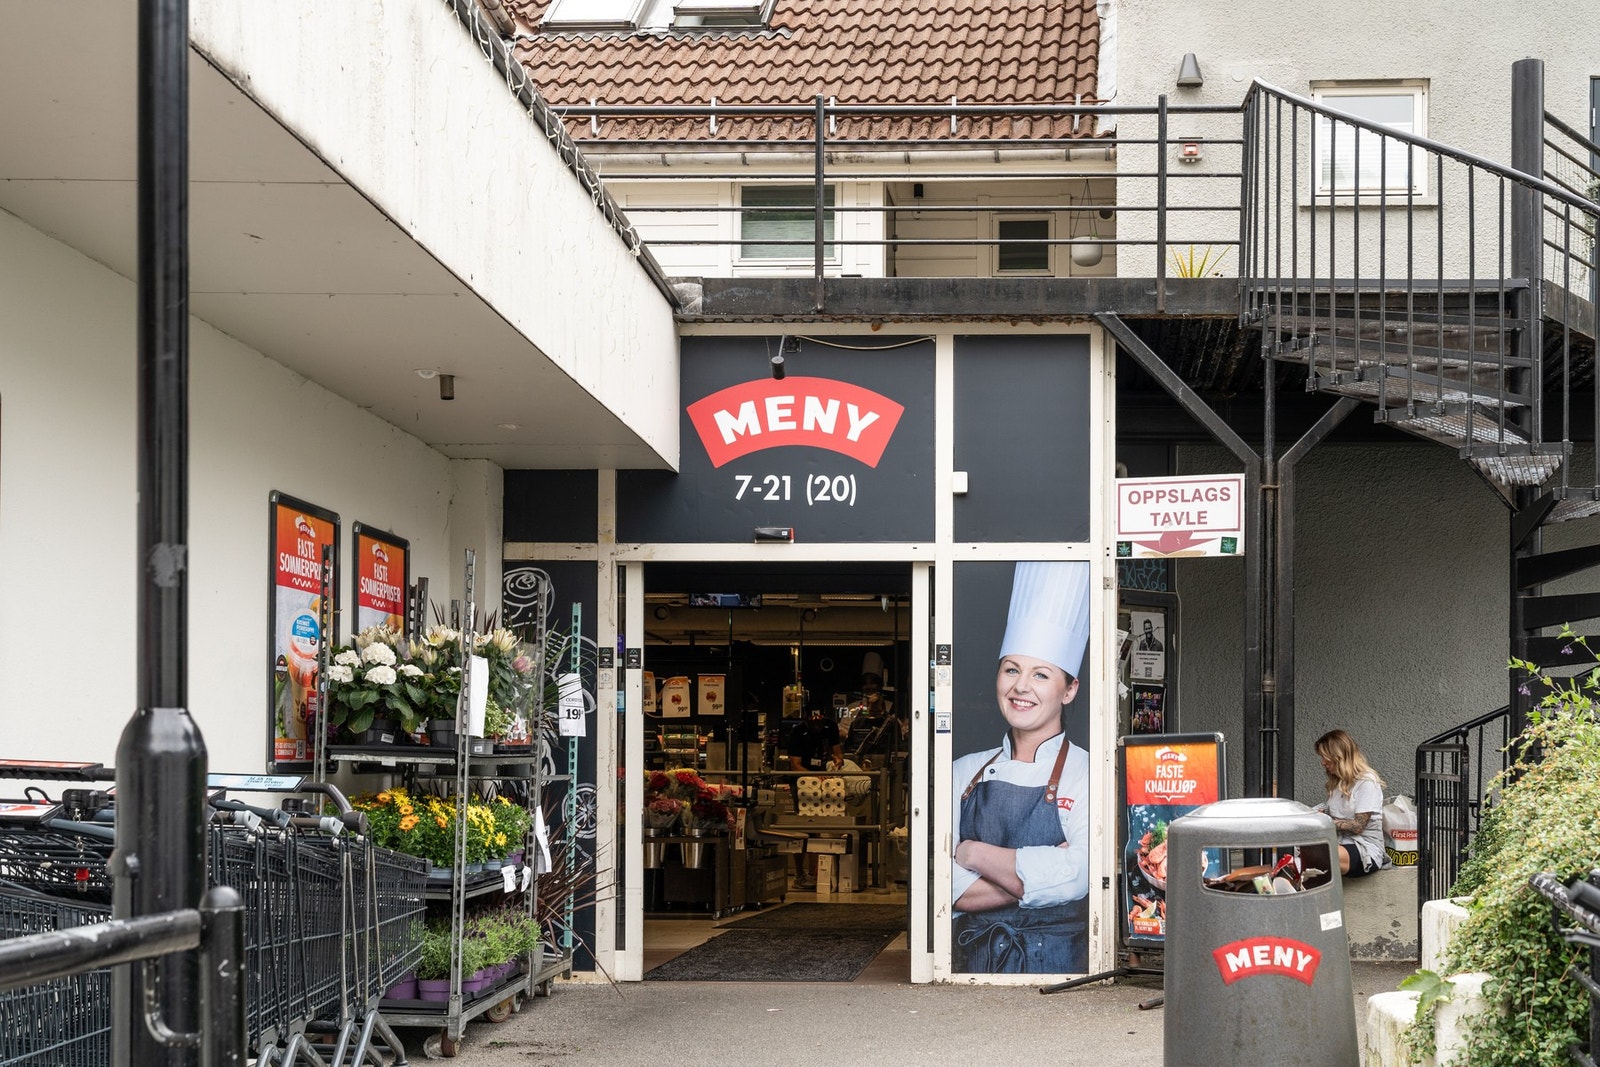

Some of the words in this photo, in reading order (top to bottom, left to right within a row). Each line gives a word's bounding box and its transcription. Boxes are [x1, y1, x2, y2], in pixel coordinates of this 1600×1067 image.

[713, 395, 880, 445] MENY
[735, 475, 791, 501] 7-21
[806, 473, 857, 507] (20)
[1128, 486, 1231, 505] OPPSLAGS
[1150, 510, 1208, 527] TAVLE
[297, 537, 316, 560] FASTE
[280, 552, 333, 583] SOMMERPRI
[373, 562, 388, 582] FASTE
[360, 575, 402, 603] SOMMERPRISER
[1161, 752, 1180, 761] MENY
[1155, 764, 1184, 779] FASTE
[1144, 779, 1197, 794] KNALLKJØP
[1057, 799, 1073, 808] EN
[1392, 830, 1406, 838] First
[1225, 944, 1313, 973] MENY
